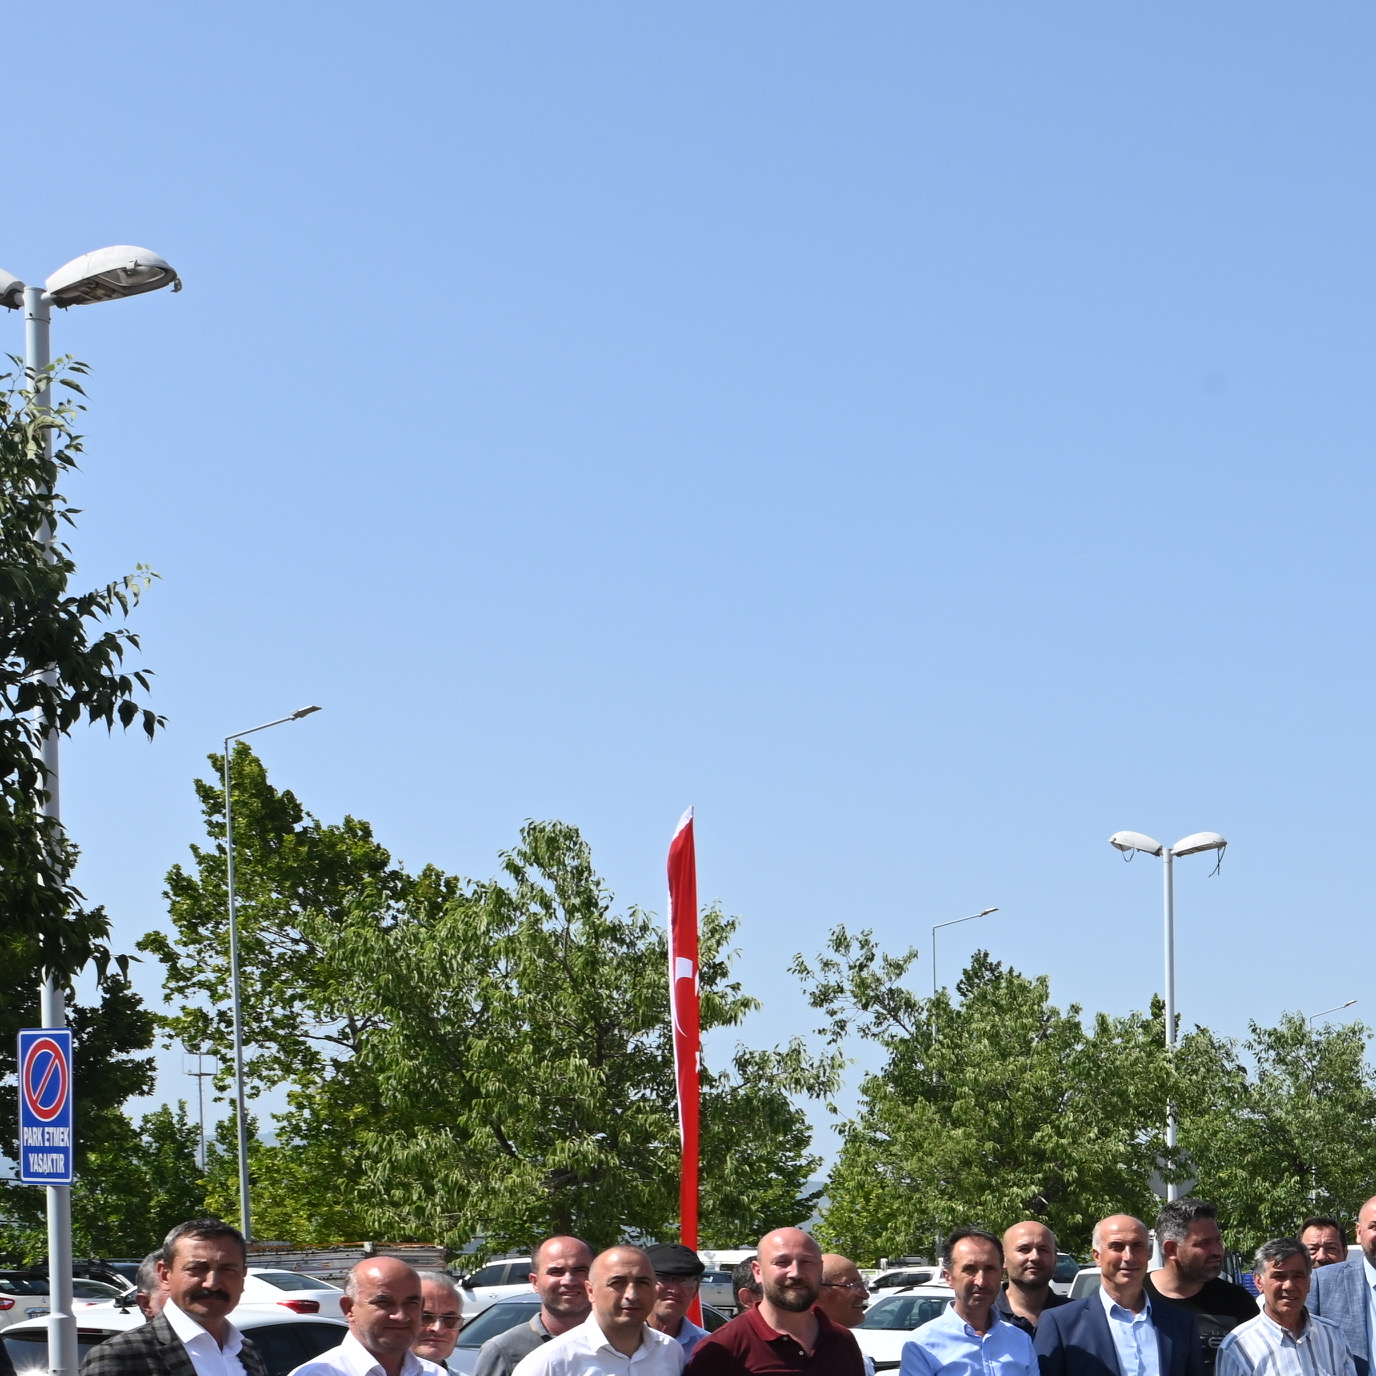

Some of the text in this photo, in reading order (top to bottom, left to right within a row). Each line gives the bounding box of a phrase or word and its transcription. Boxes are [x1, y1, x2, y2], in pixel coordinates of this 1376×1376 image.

[23, 1127, 70, 1147] PARK ETMEK
[28, 1153, 65, 1173] YASAKTIR
